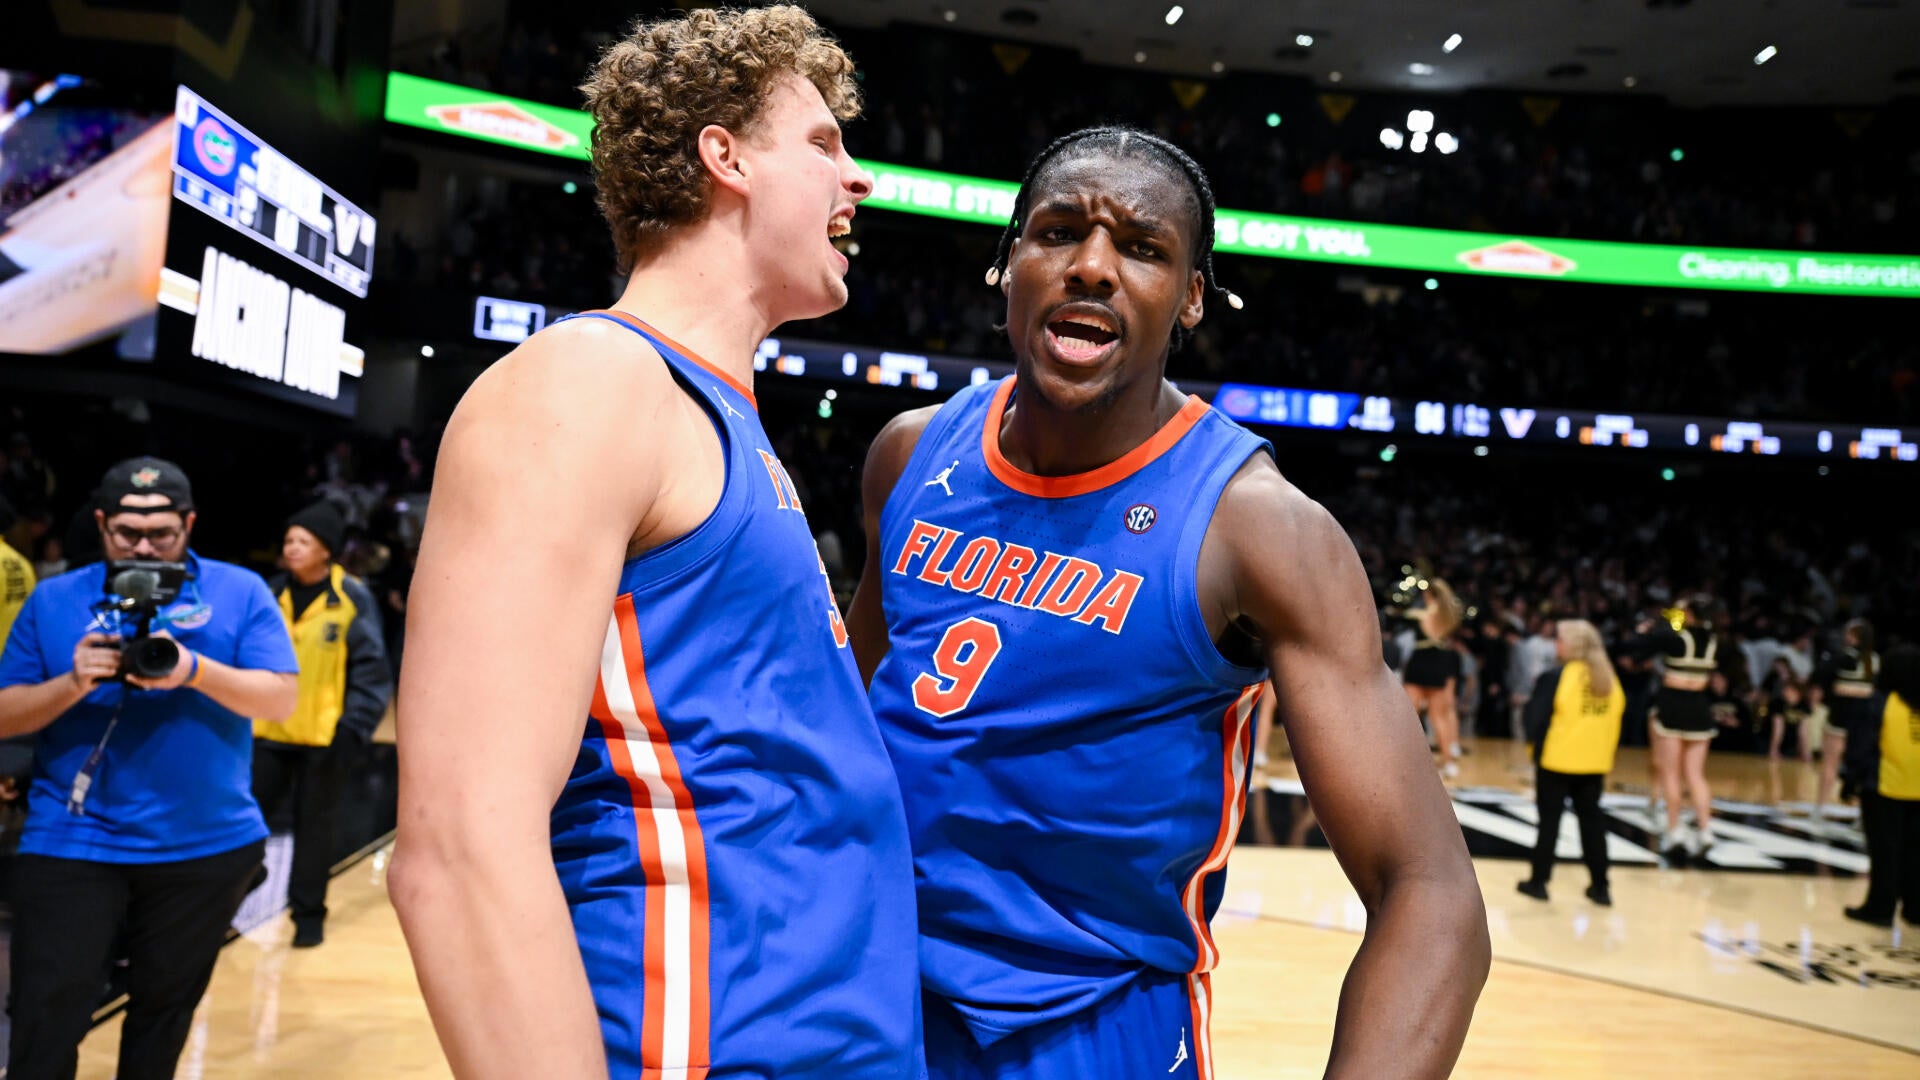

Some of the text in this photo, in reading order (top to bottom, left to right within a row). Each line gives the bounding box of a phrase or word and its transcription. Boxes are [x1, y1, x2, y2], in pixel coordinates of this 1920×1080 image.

[1241, 219, 1300, 251] GOT
[1797, 257, 1920, 288] Restorati
[1127, 505, 1155, 531] SEC
[891, 519, 1144, 635] FLORIDA
[911, 616, 1002, 718] 9
